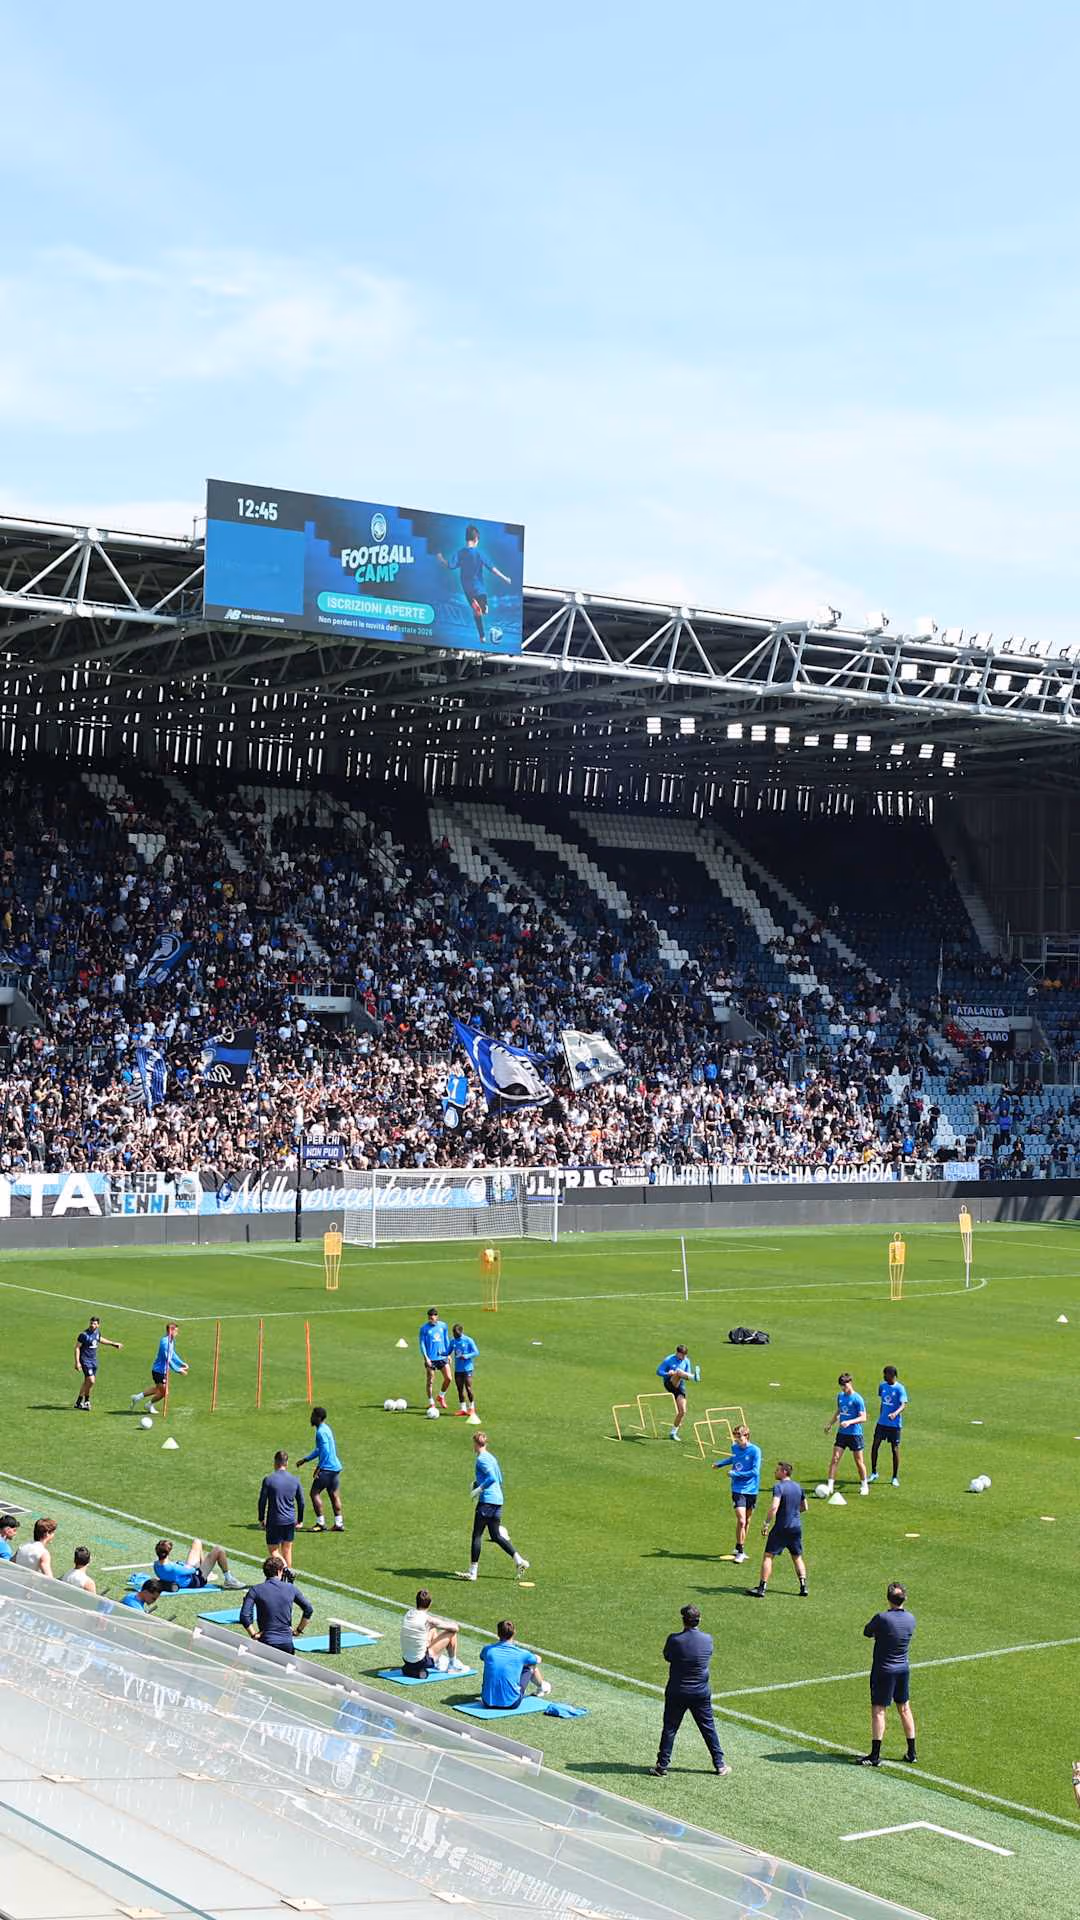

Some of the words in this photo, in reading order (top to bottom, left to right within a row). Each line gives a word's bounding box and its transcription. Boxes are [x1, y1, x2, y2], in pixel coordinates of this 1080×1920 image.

[237, 498, 278, 521] 12:45
[341, 544, 414, 569] FOOTBALL
[354, 563, 400, 583] CAMP
[327, 596, 382, 614] ISCRIZIONI
[384, 604, 425, 619] APERTE
[318, 616, 331, 624] Non
[957, 1006, 1005, 1017] ATALANTA
[306, 1135, 325, 1145] PER
[326, 1135, 340, 1145] CHI
[306, 1147, 322, 1157] NON
[521, 1168, 615, 1196] ULTRAS
[748, 1164, 813, 1185] VECCHIA
[828, 1162, 893, 1184] GUARDIA
